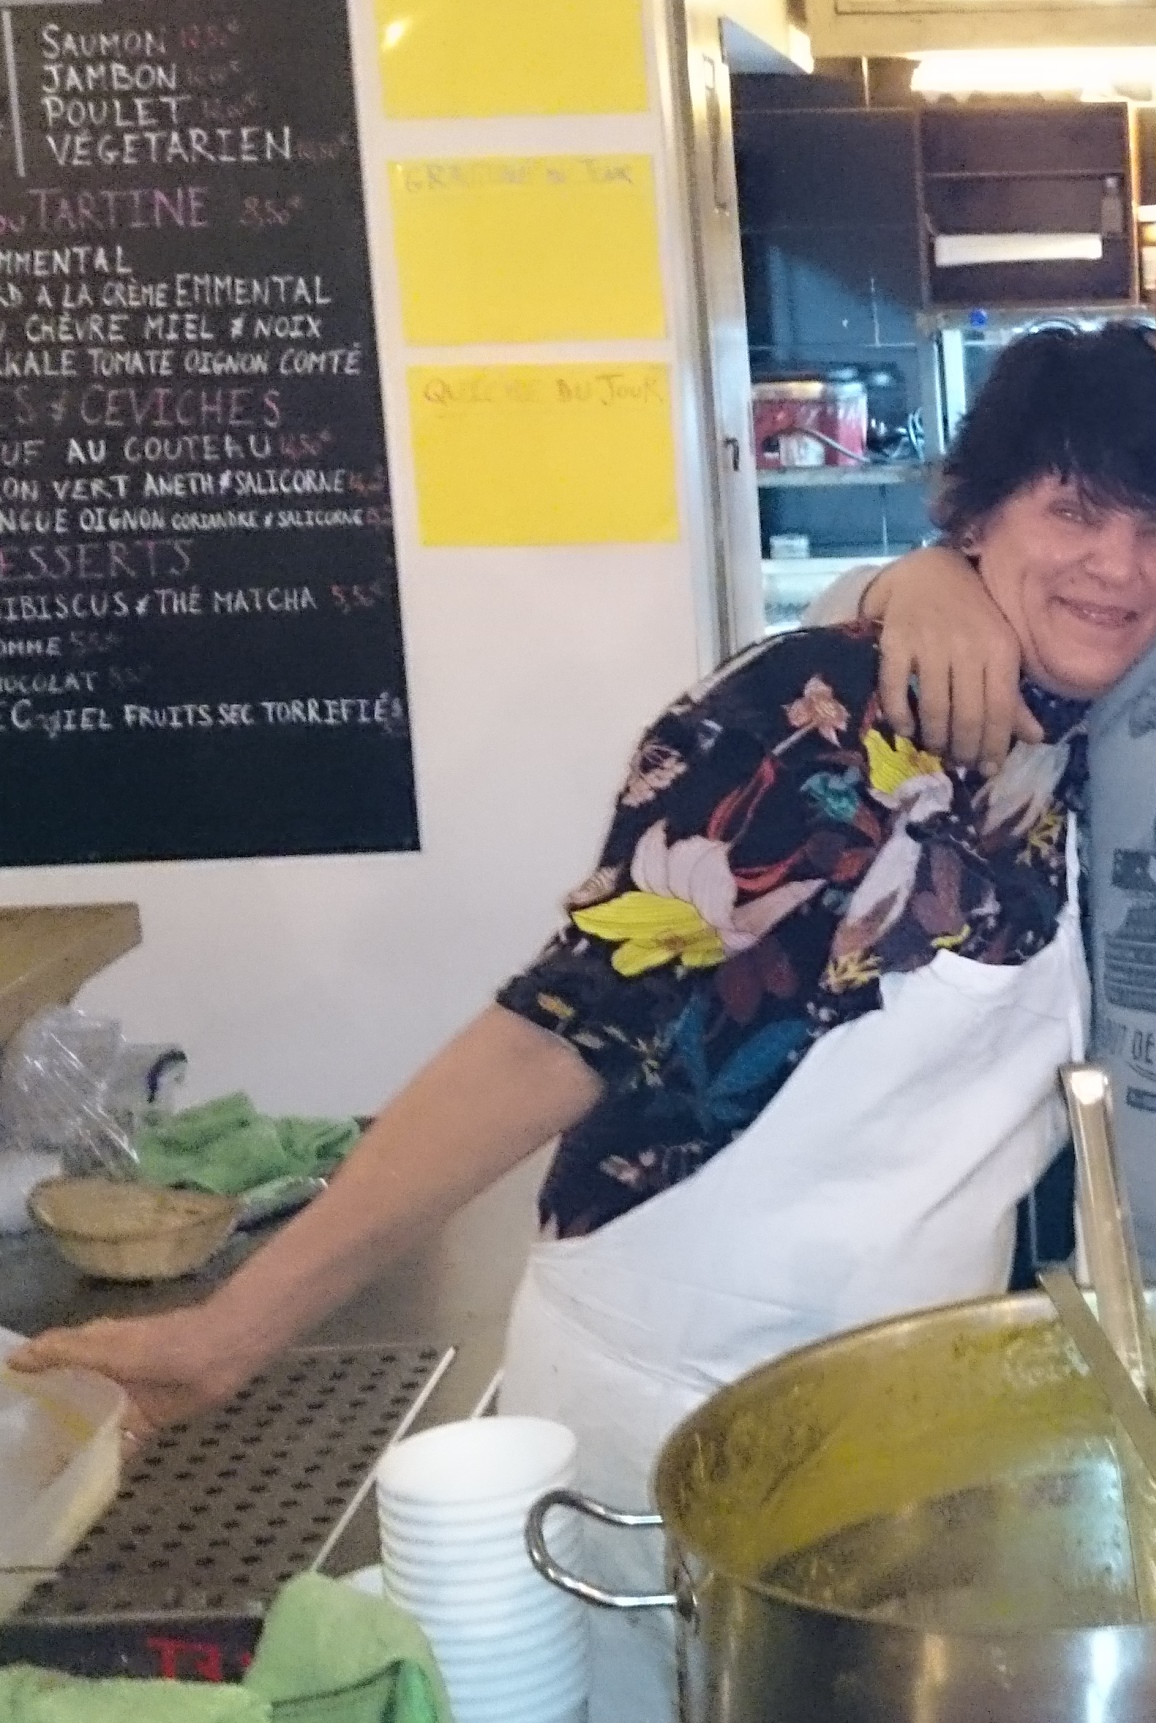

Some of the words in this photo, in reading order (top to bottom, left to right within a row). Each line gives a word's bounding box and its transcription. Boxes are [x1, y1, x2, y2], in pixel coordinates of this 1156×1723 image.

[42, 24, 166, 59] SAUMON
[42, 62, 177, 94] JAMBON
[42, 95, 190, 127] POULET
[27, 186, 208, 231] TARTINE
[63, 282, 94, 308] LA
[175, 272, 332, 306] EMMENTAL
[143, 313, 215, 341] MIEL
[254, 313, 323, 340] NOIX
[87, 347, 174, 377] TOMATE
[184, 350, 271, 376] OIGNON
[279, 342, 362, 375] COMTÉ
[80, 382, 283, 428] CEVICHES
[67, 437, 107, 466] AU
[124, 432, 271, 465] COUTEAU
[52, 475, 130, 501] VERT
[144, 471, 214, 499] ANETH
[235, 468, 347, 496] SALICORNE
[80, 507, 165, 533] OIGNON
[214, 587, 318, 615] MATCHA
[125, 704, 209, 730] FRUITS
[1131, 1029, 1155, 1065] DE
